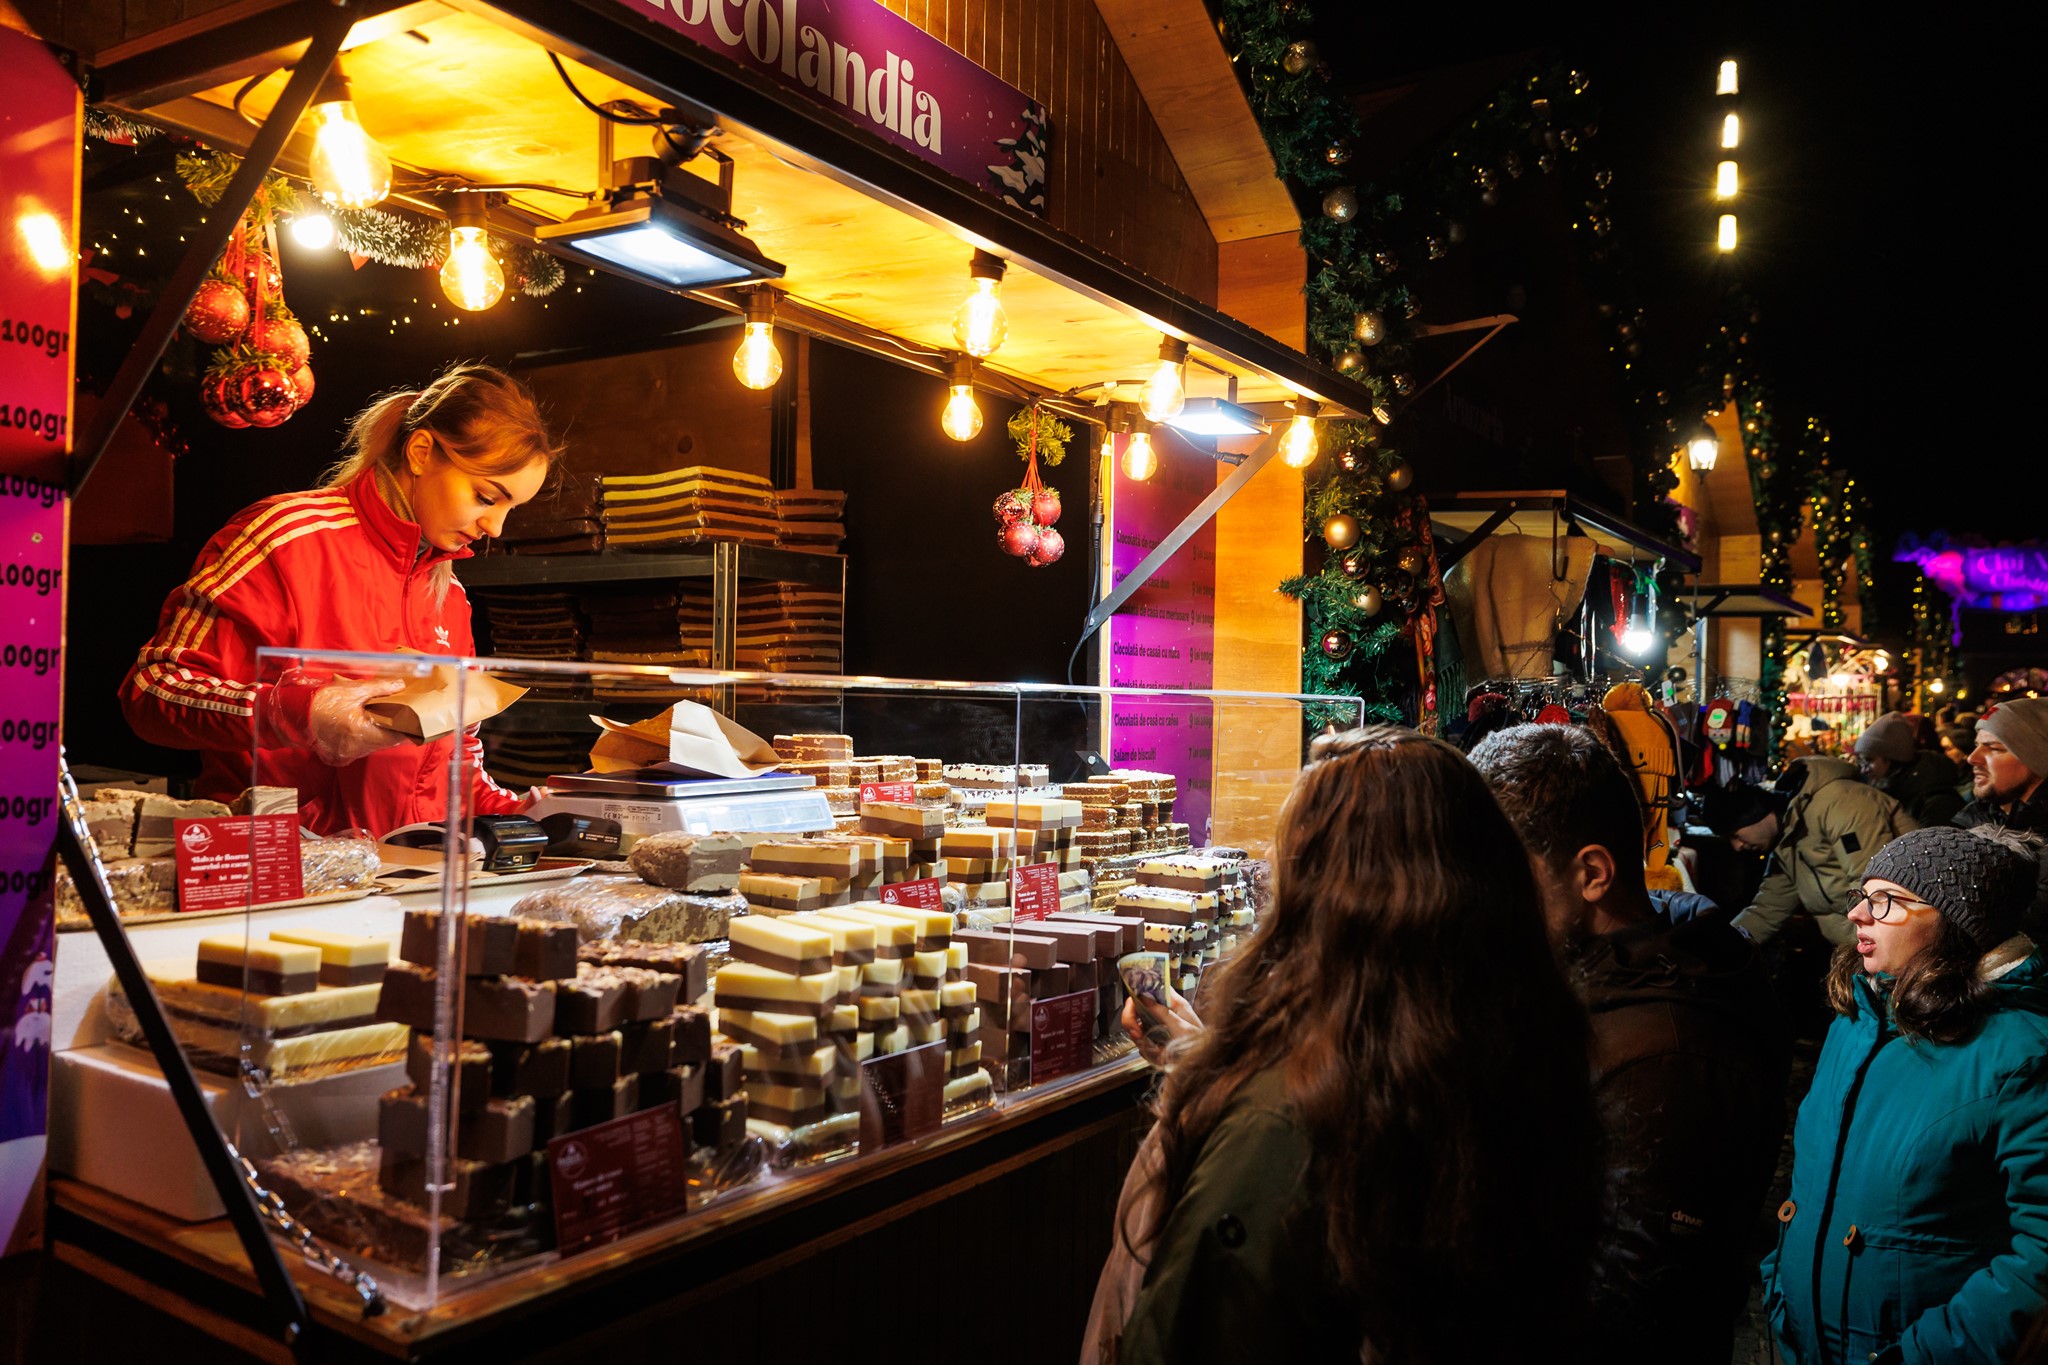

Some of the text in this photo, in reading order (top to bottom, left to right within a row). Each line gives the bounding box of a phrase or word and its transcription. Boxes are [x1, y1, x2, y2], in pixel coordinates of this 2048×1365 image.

[1, 319, 69, 358] 100gr
[0, 405, 67, 441] 100gr
[0, 563, 62, 596] 00gr
[0, 645, 60, 675] 00gr
[1113, 642, 1139, 656] Ciocolată
[1139, 644, 1146, 657] de
[1189, 647, 1193, 663] 9
[1114, 713, 1139, 726] Ciocolată
[1139, 713, 1146, 726] de
[1113, 748, 1130, 762] Salam
[1130, 748, 1137, 761] de
